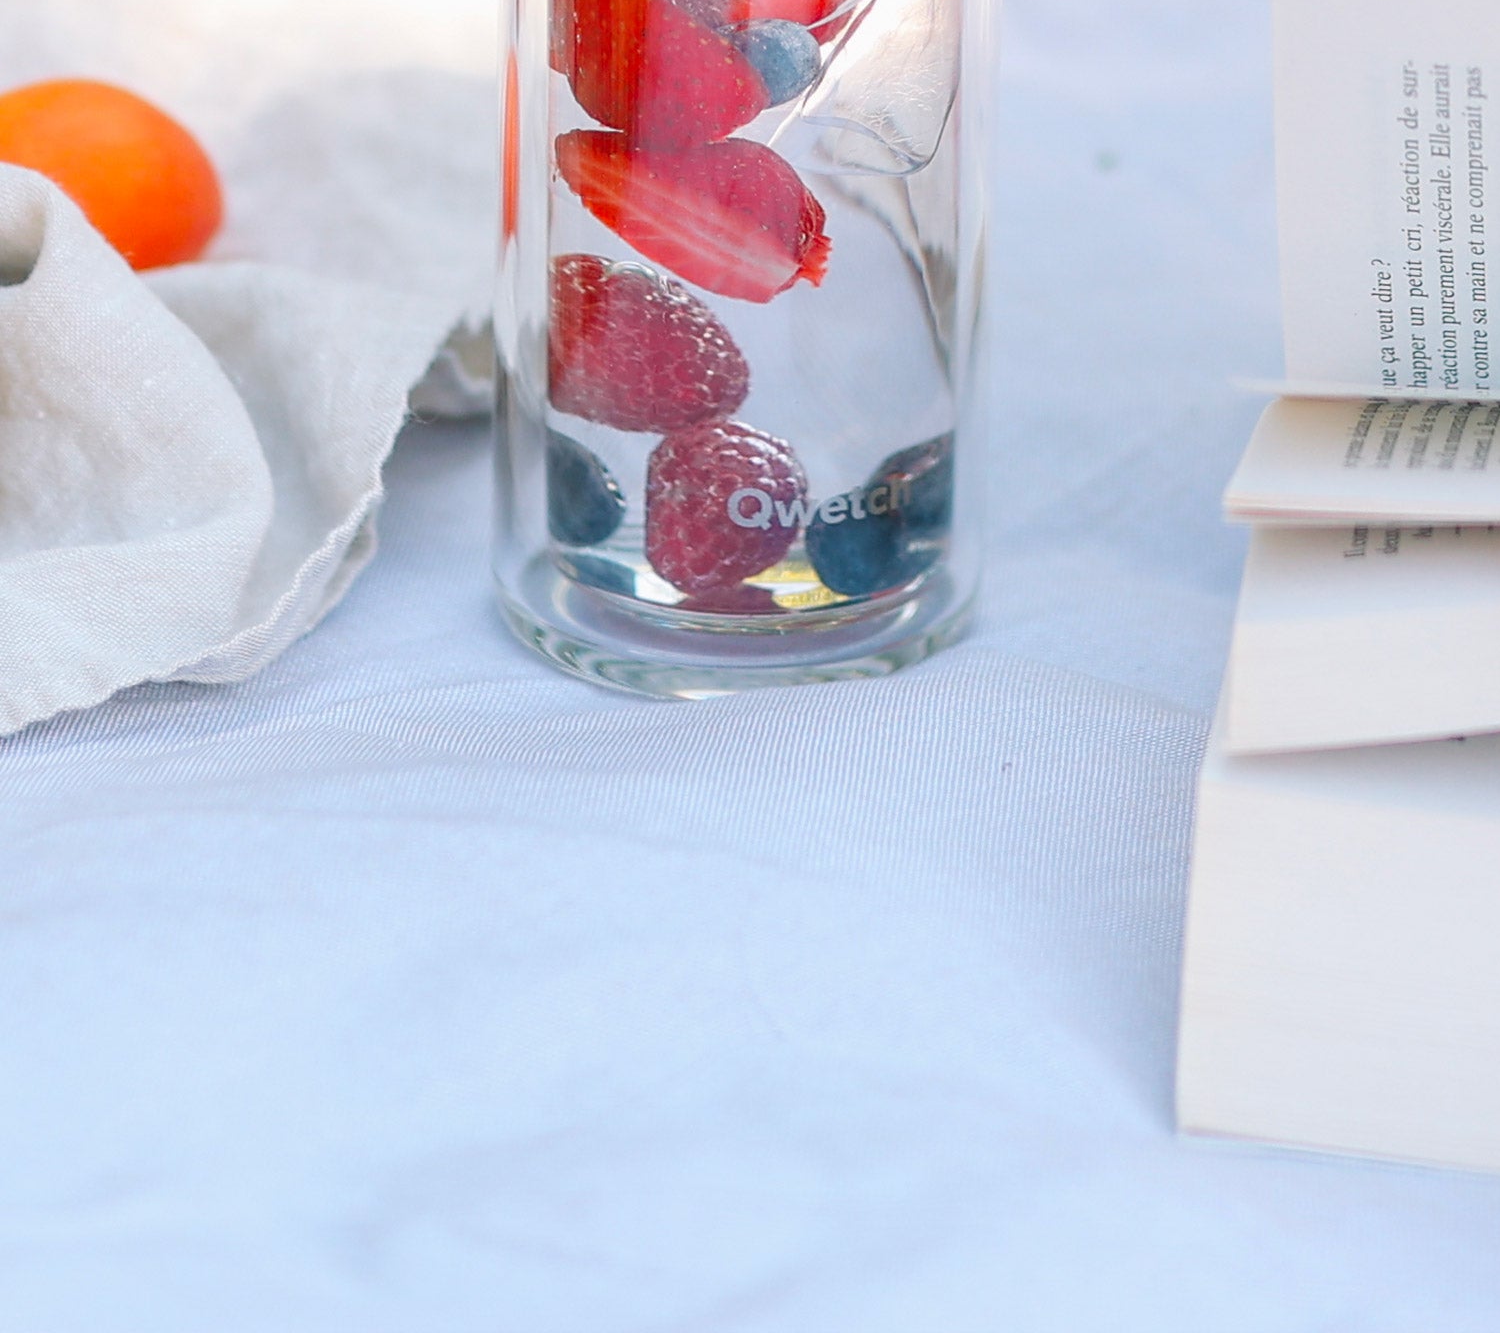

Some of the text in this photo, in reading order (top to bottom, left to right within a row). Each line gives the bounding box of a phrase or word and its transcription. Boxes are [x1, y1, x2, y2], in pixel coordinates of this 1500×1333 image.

[1398, 139, 1419, 214] réaction
[1461, 105, 1488, 209] comprenait
[1466, 239, 1484, 256] et
[1469, 214, 1483, 234] ne
[1402, 260, 1429, 298] petit
[1436, 248, 1462, 325] purement
[1465, 261, 1486, 302] main
[1371, 271, 1400, 390] ue ça veut dire
[1410, 306, 1424, 327] un
[1472, 308, 1487, 325] sa
[1437, 330, 1459, 390] réaction
[1470, 330, 1489, 379] contre
[727, 478, 911, 530] Qwetch
